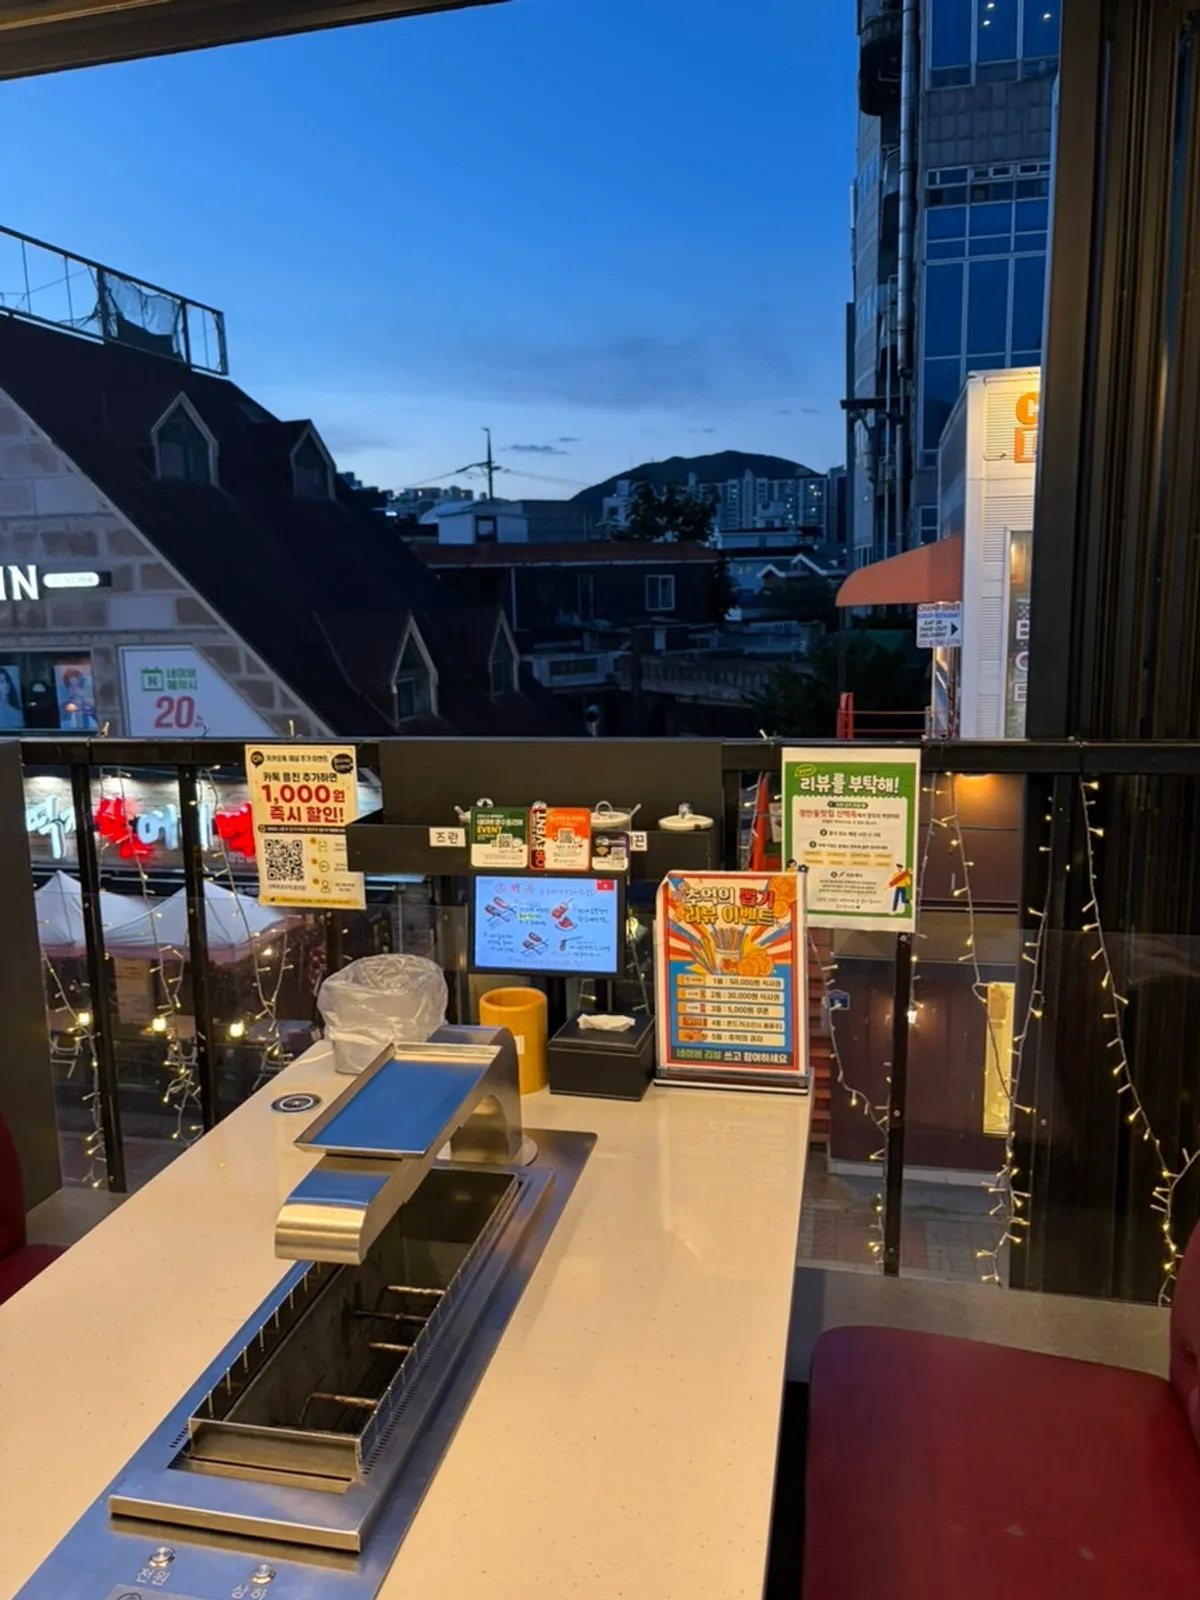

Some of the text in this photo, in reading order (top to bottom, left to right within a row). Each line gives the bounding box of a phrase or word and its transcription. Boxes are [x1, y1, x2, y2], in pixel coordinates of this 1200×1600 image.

[261, 784, 345, 804] 1,000원
[800, 773, 900, 795] 리뷰를 부탁해!
[270, 806, 344, 823] 즉시 할인!
[683, 886, 775, 909] 추억의 뽑기
[684, 905, 775, 927] 리뷰 이벤트
[676, 1048, 788, 1064] 네이버 리뷰 쓰고 참여하세요
